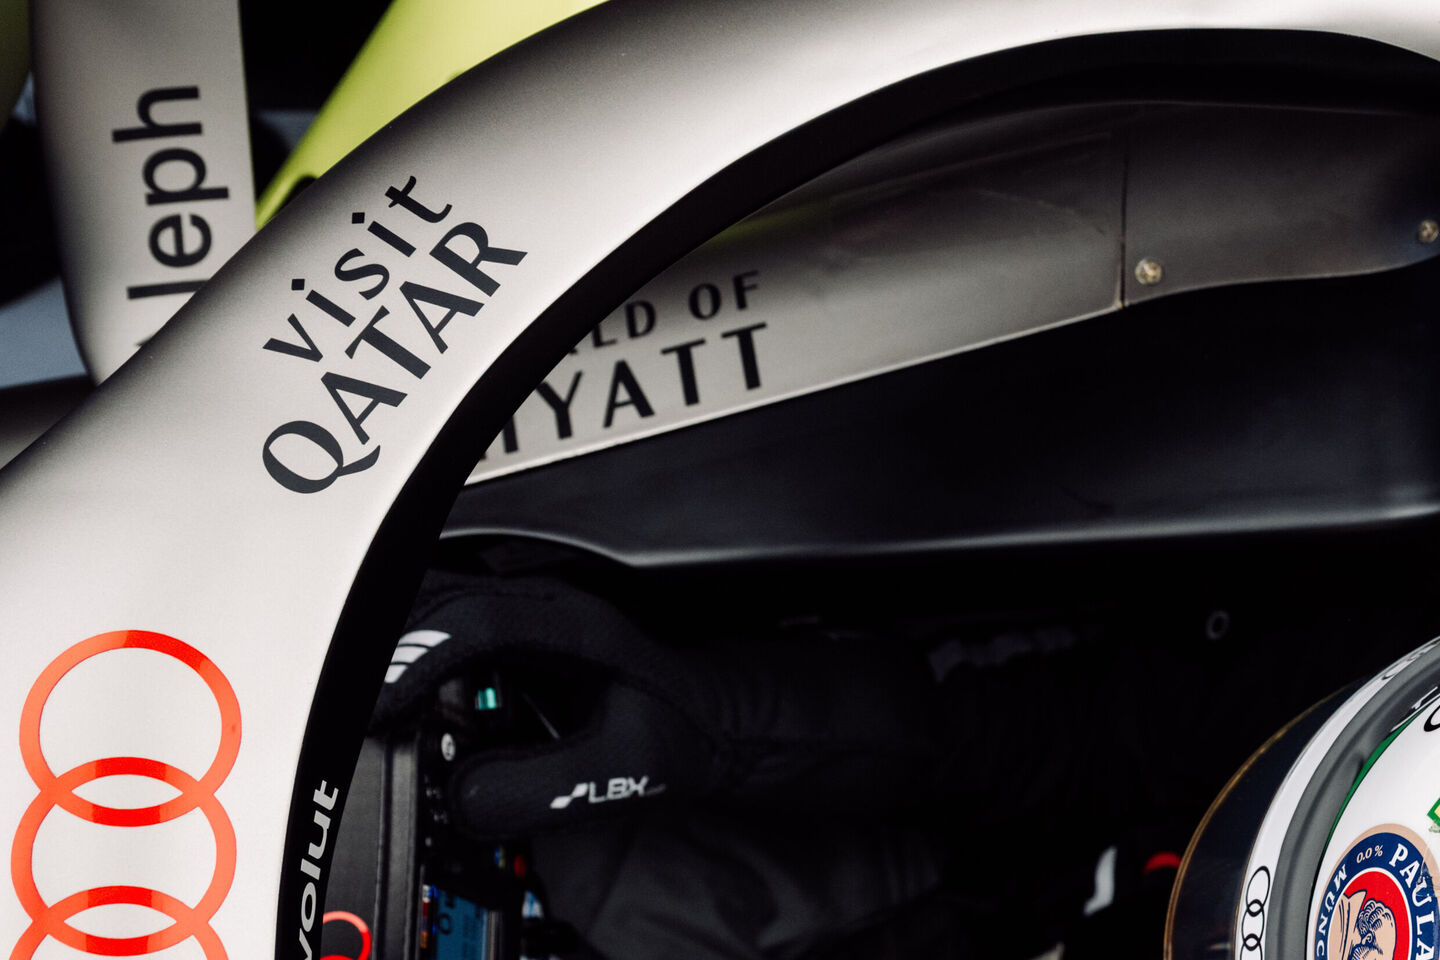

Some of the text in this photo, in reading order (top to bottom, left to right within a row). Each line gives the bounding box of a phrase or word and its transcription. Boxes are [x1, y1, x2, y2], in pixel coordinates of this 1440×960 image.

[111, 85, 229, 347] leph
[262, 176, 452, 363] visit
[688, 270, 758, 319] OF
[262, 222, 528, 494] QATAR
